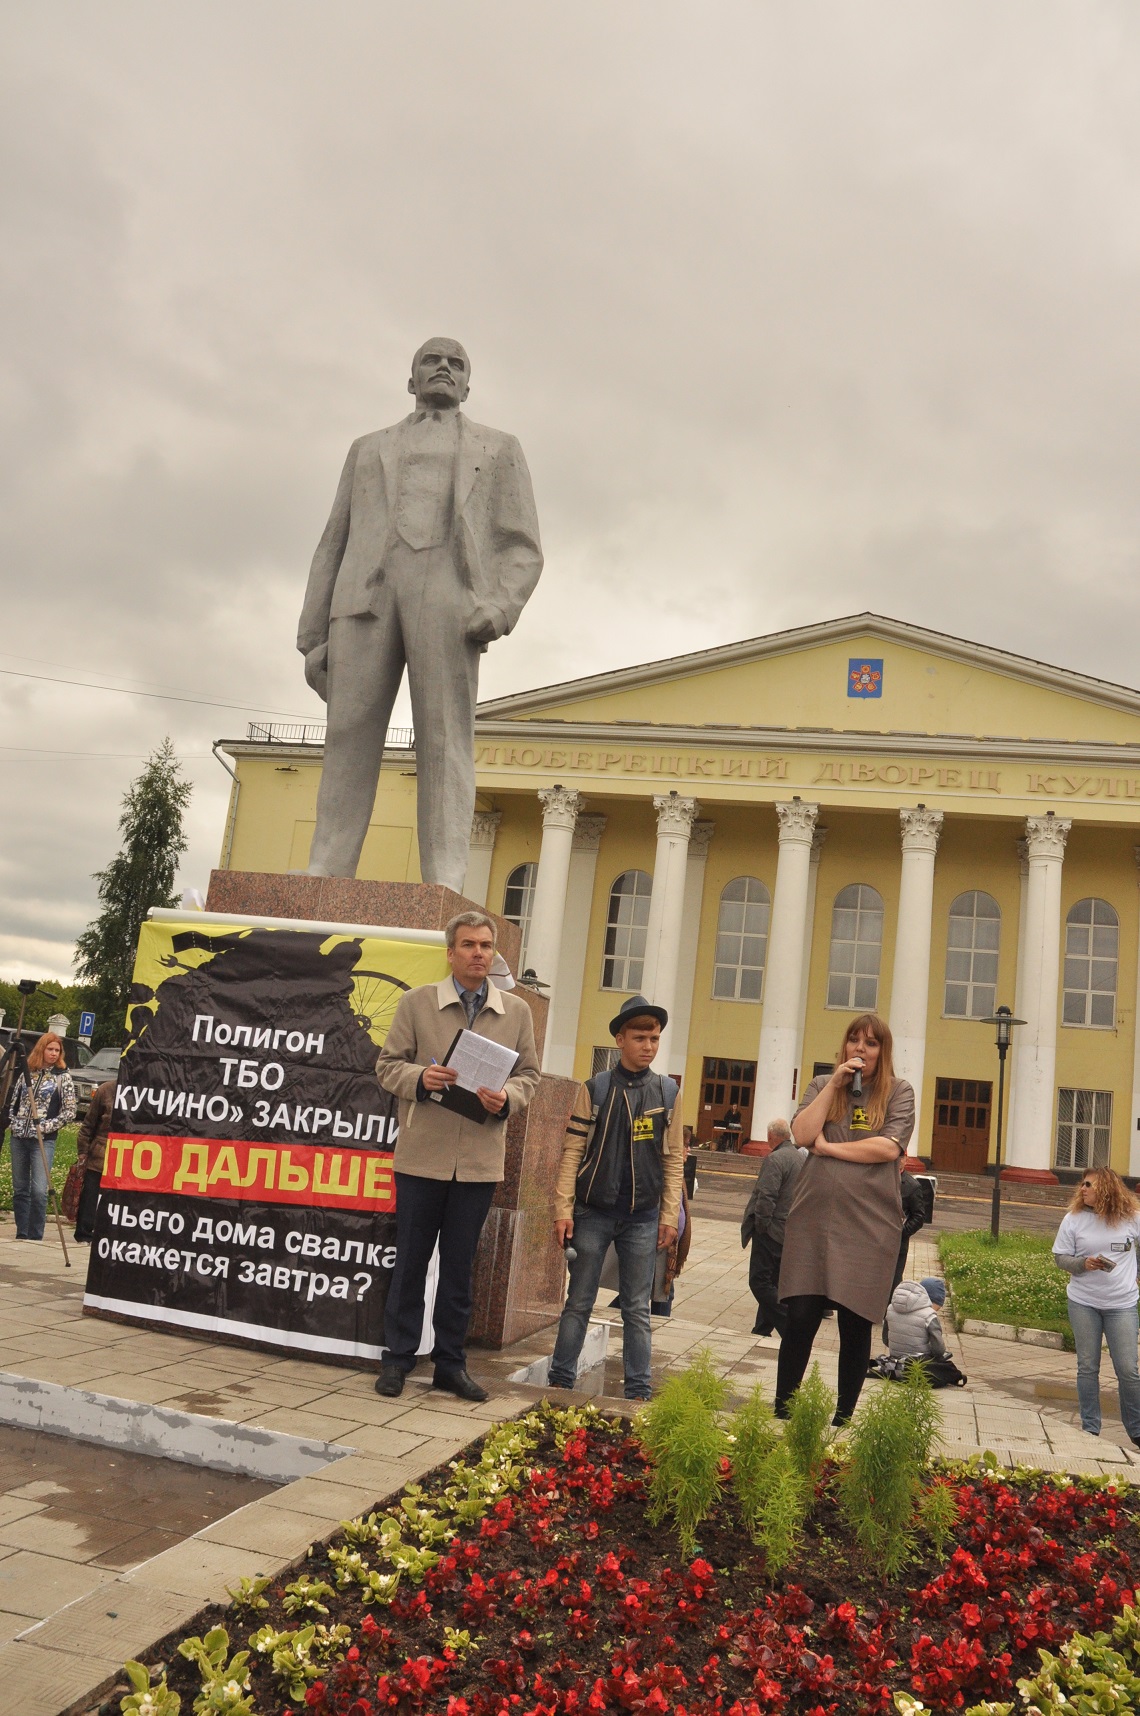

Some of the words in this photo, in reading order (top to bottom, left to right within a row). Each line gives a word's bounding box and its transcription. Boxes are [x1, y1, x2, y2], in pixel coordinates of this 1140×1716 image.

[474, 746, 789, 779] ЛЮБЕРЕЦКИЙ
[812, 761, 1002, 795] ДВОРЕЦ
[83, 1015, 92, 1033] P
[191, 1014, 325, 1055] Полигон
[219, 1057, 285, 1091] ТБО
[114, 1084, 244, 1123] КУЧИНО»
[173, 1143, 394, 1200] ДАЛЬШЕ
[107, 1203, 185, 1235] чьего
[191, 1216, 276, 1250] дома
[285, 1230, 398, 1269] свалка
[98, 1237, 230, 1279] окажется
[237, 1261, 373, 1302] завтра?
